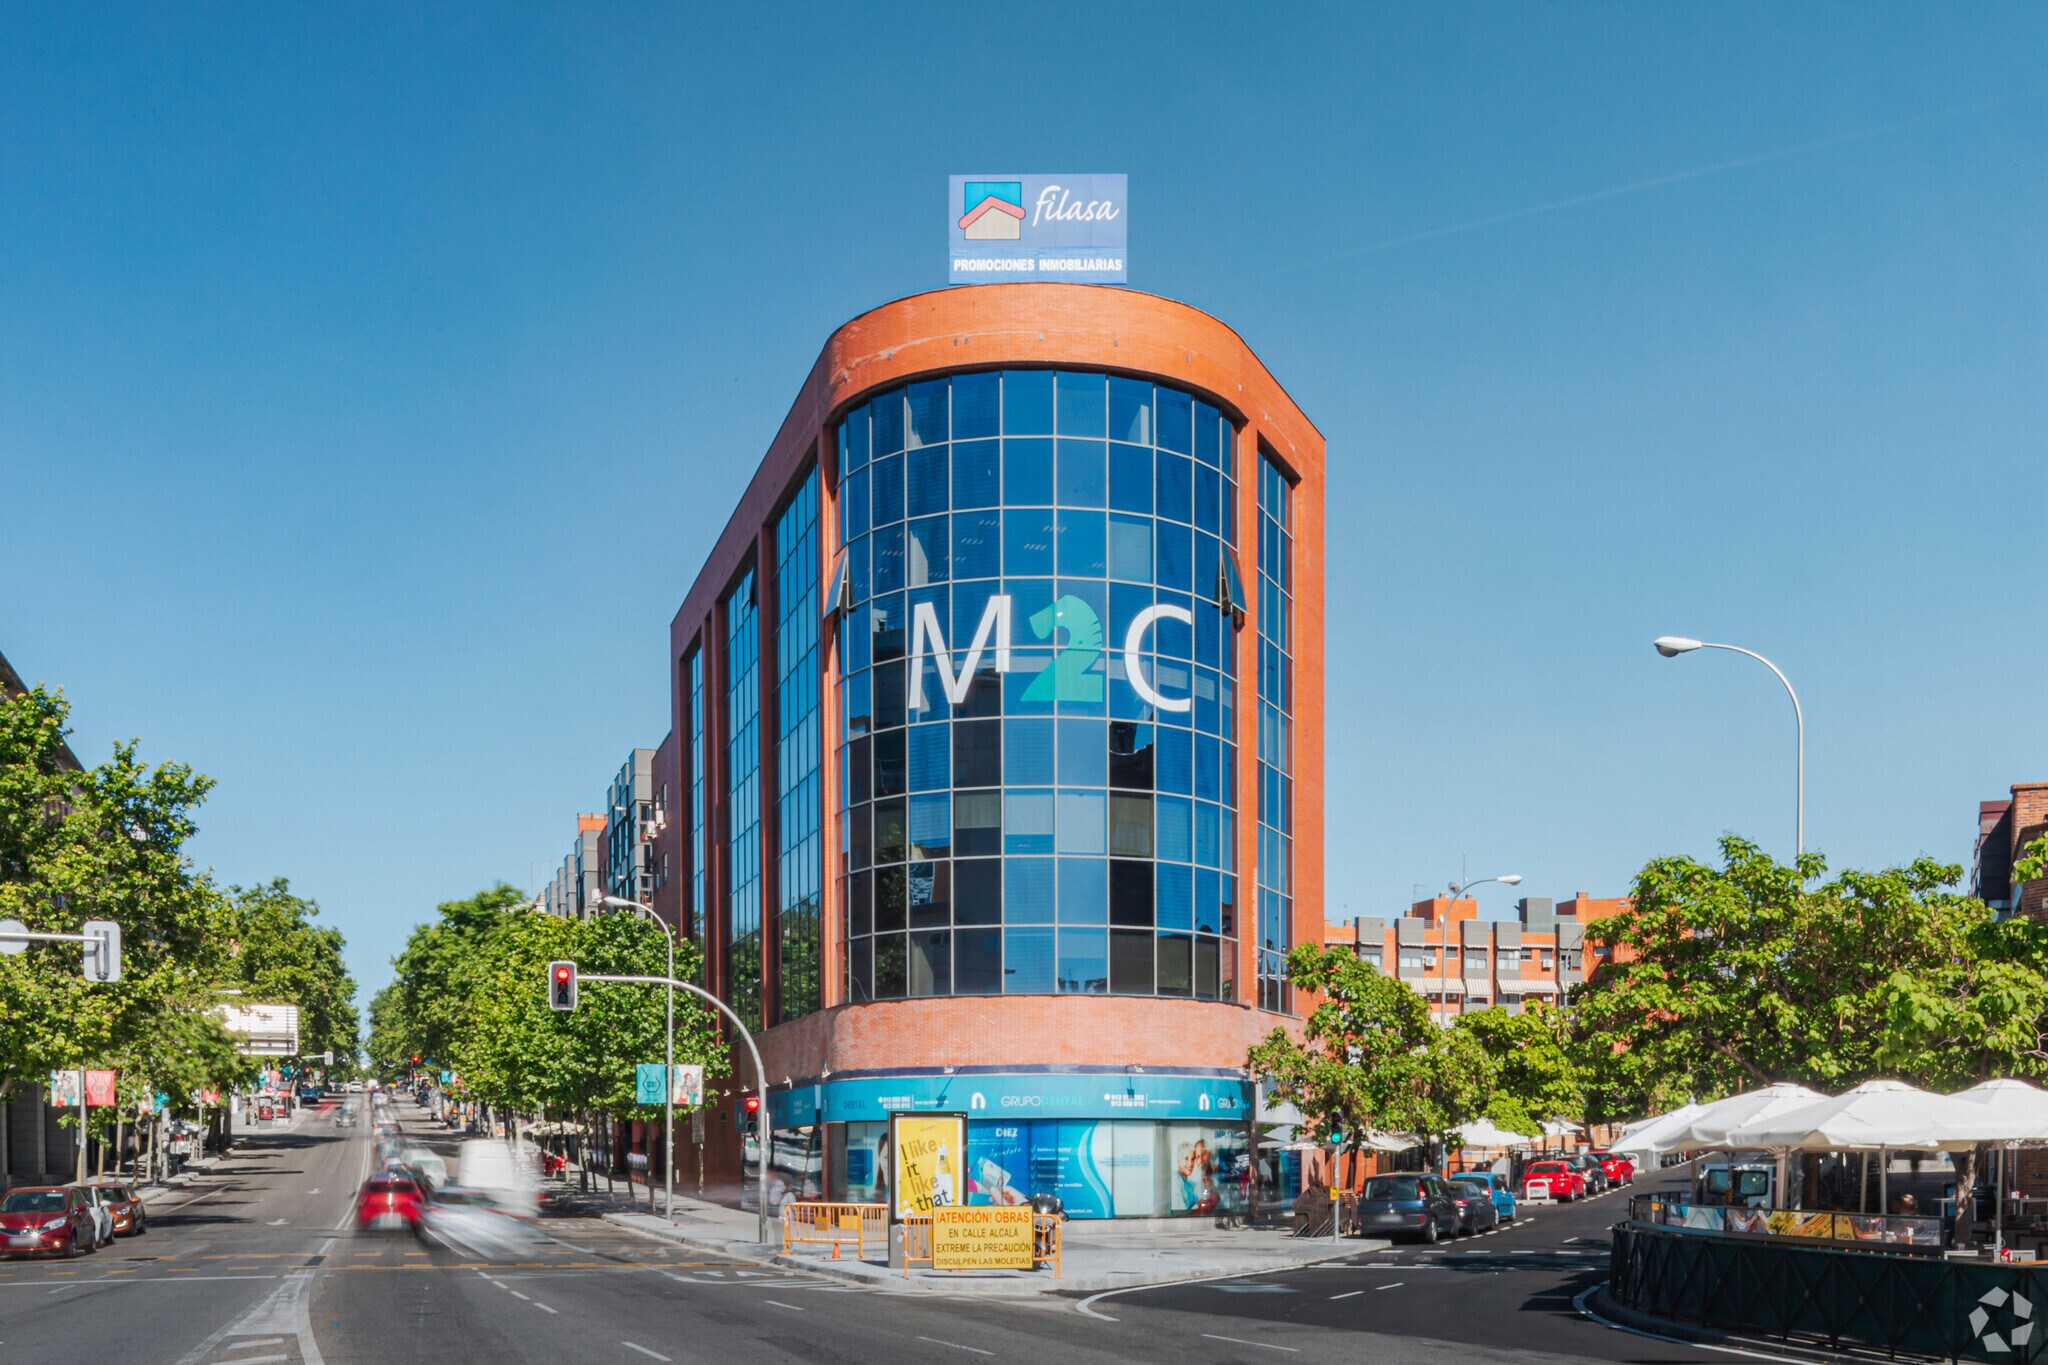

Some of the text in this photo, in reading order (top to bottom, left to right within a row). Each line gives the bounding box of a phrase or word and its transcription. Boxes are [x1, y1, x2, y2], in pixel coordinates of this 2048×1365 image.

[1032, 185, 1120, 227] filasa
[953, 258, 1122, 272] PROMOCIONES INMOBILIARIAS
[908, 594, 1192, 713] M2C
[995, 1127, 1018, 1138] DIEZ
[900, 1139, 938, 1161] I like
[905, 1161, 920, 1178] it
[910, 1175, 939, 1195] like
[936, 1210, 1030, 1224] ¡ATENCIÓN! OBRAS
[949, 1226, 1019, 1238] EN CALLE ALCALÁ
[936, 1241, 1031, 1253] EXTREME LA PRECAUCIÓN
[936, 1258, 977, 1266] DISCULPEN
